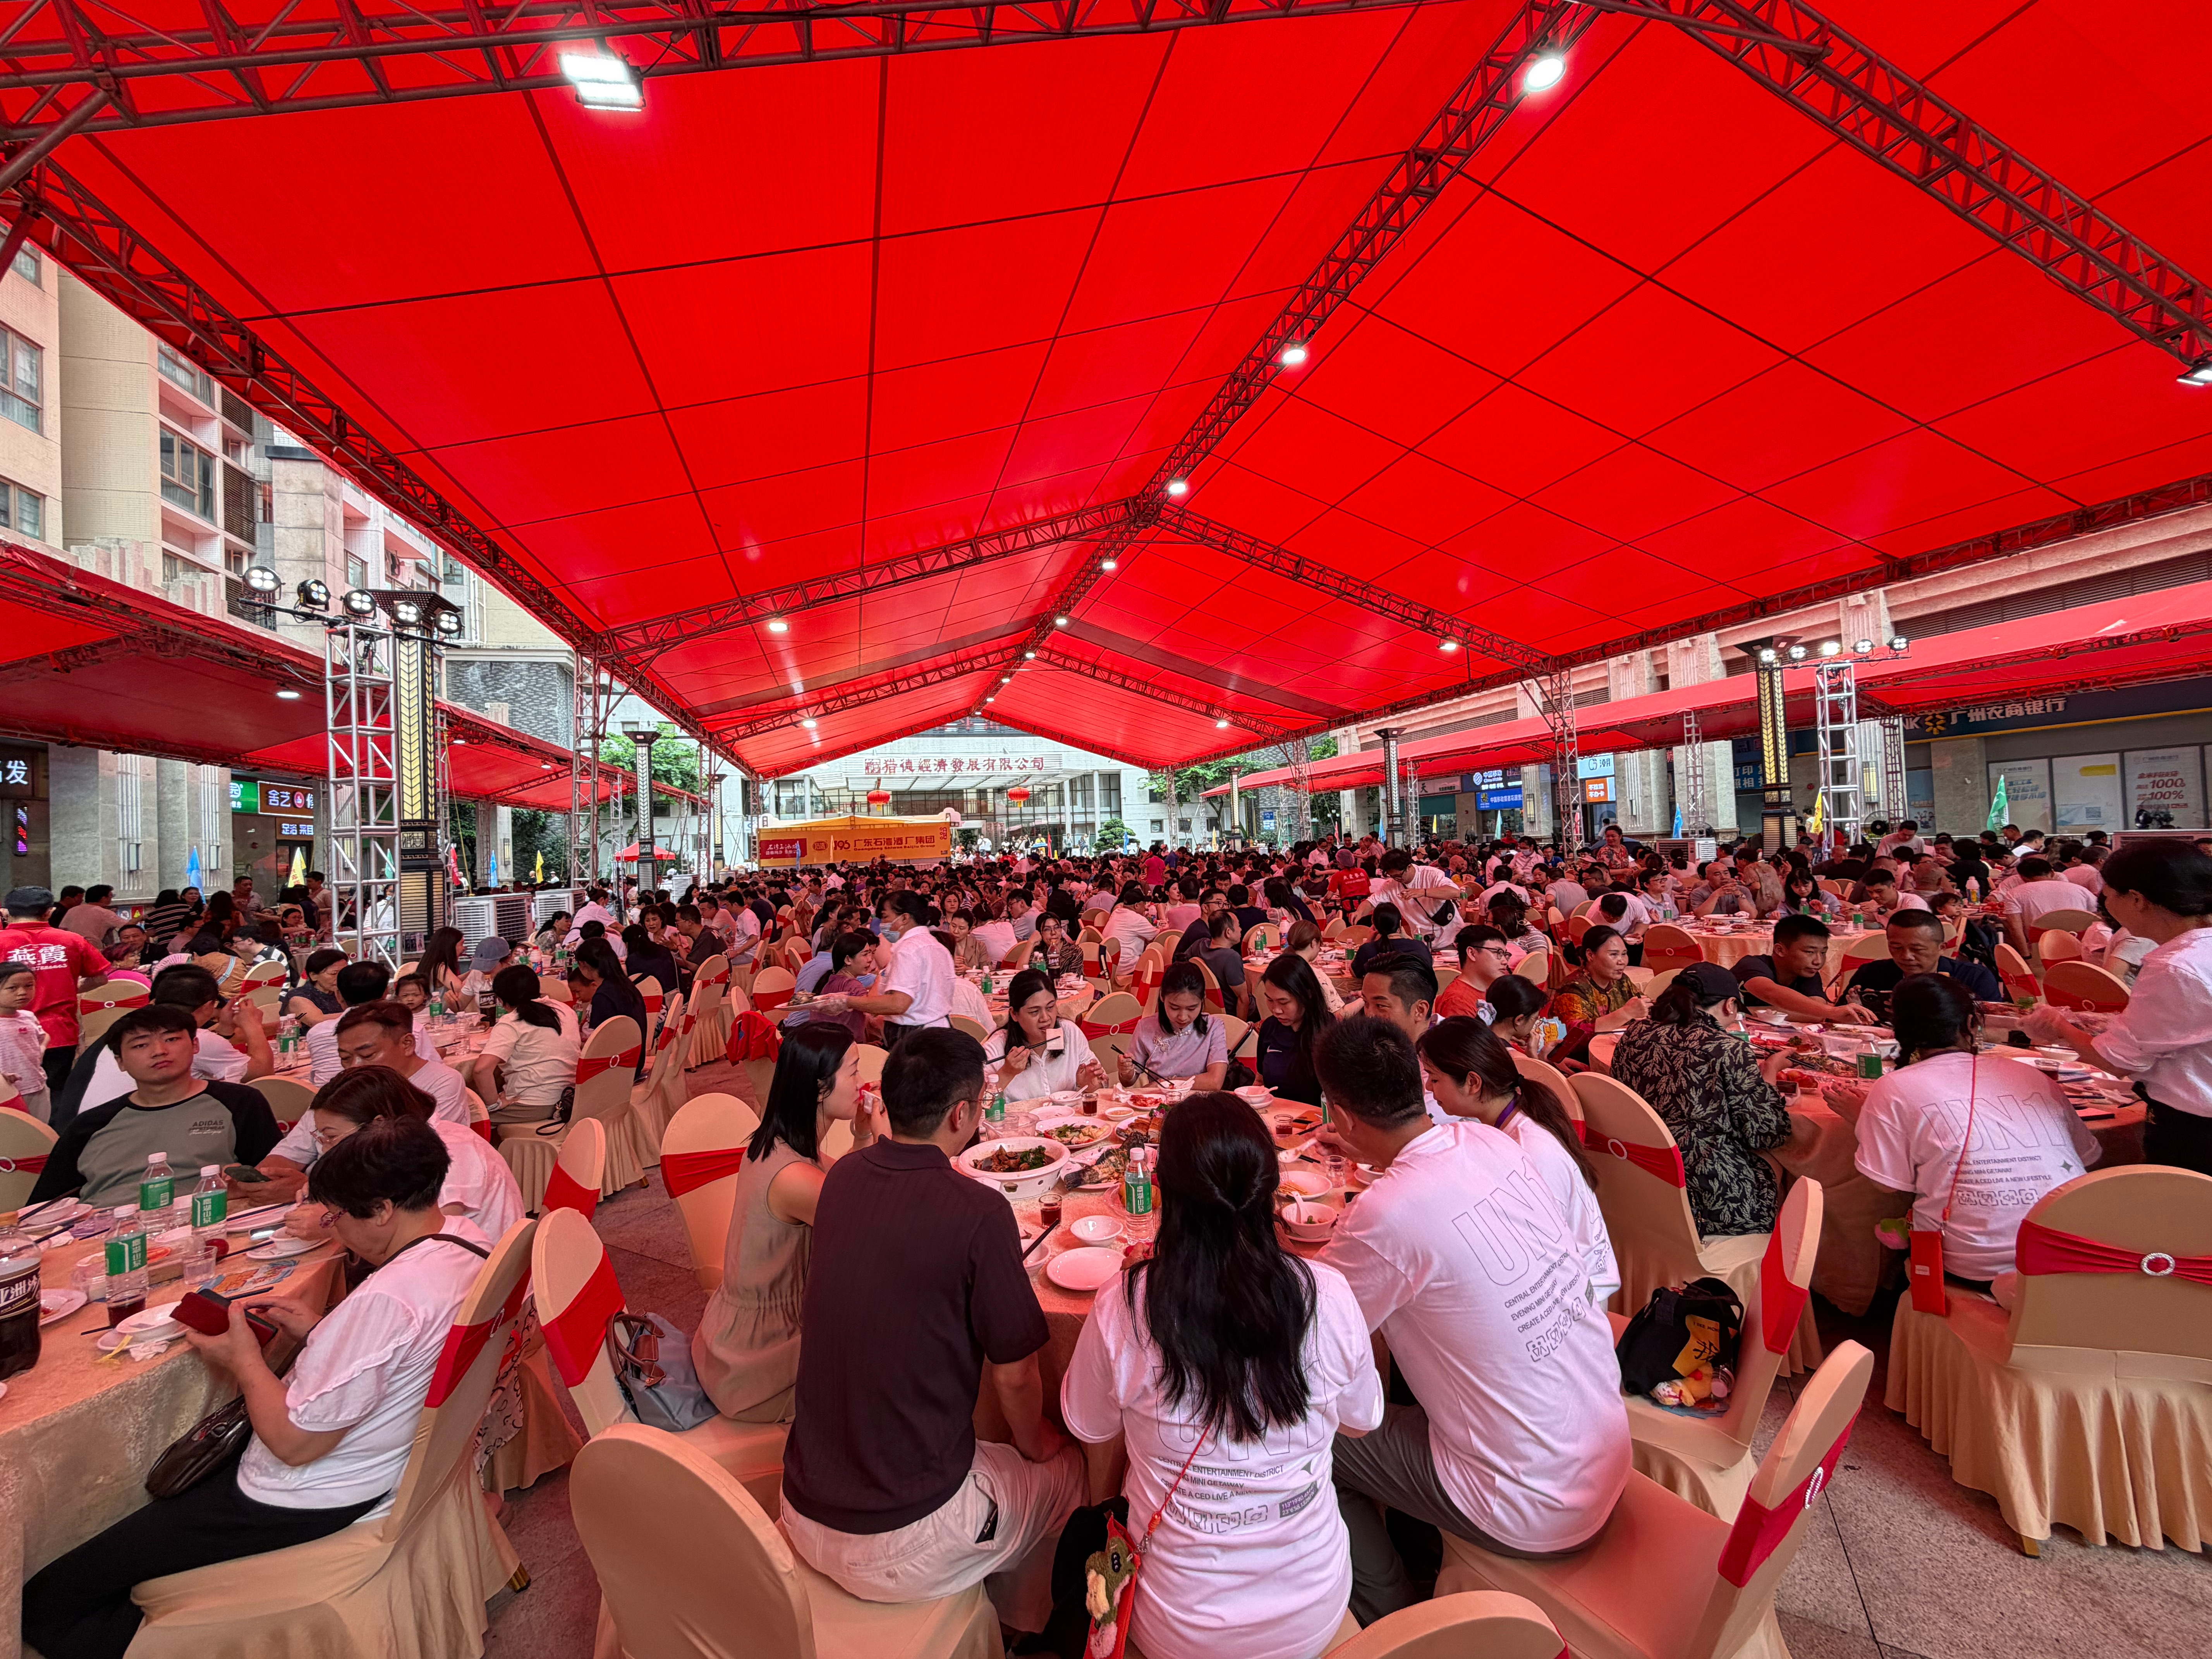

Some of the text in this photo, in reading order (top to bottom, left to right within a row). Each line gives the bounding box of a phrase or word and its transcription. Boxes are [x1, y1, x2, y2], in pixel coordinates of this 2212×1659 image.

[1950, 697, 2067, 725] 广州农商银行
[0, 760, 28, 785] 发
[854, 836, 935, 847] 广东石湾酒厂集团
[1504, 1290, 1531, 1308] CENTRAL
[1510, 1302, 1536, 1321] EVENING
[1518, 1316, 1540, 1333] CREATE
[1158, 1456, 1284, 1478] CENTRA ENTERTAINMENT DISTRICT
[1190, 1476, 1206, 1486] MINI
[1207, 1479, 1245, 1489] GETAWAY
[1188, 1490, 1194, 1498] A
